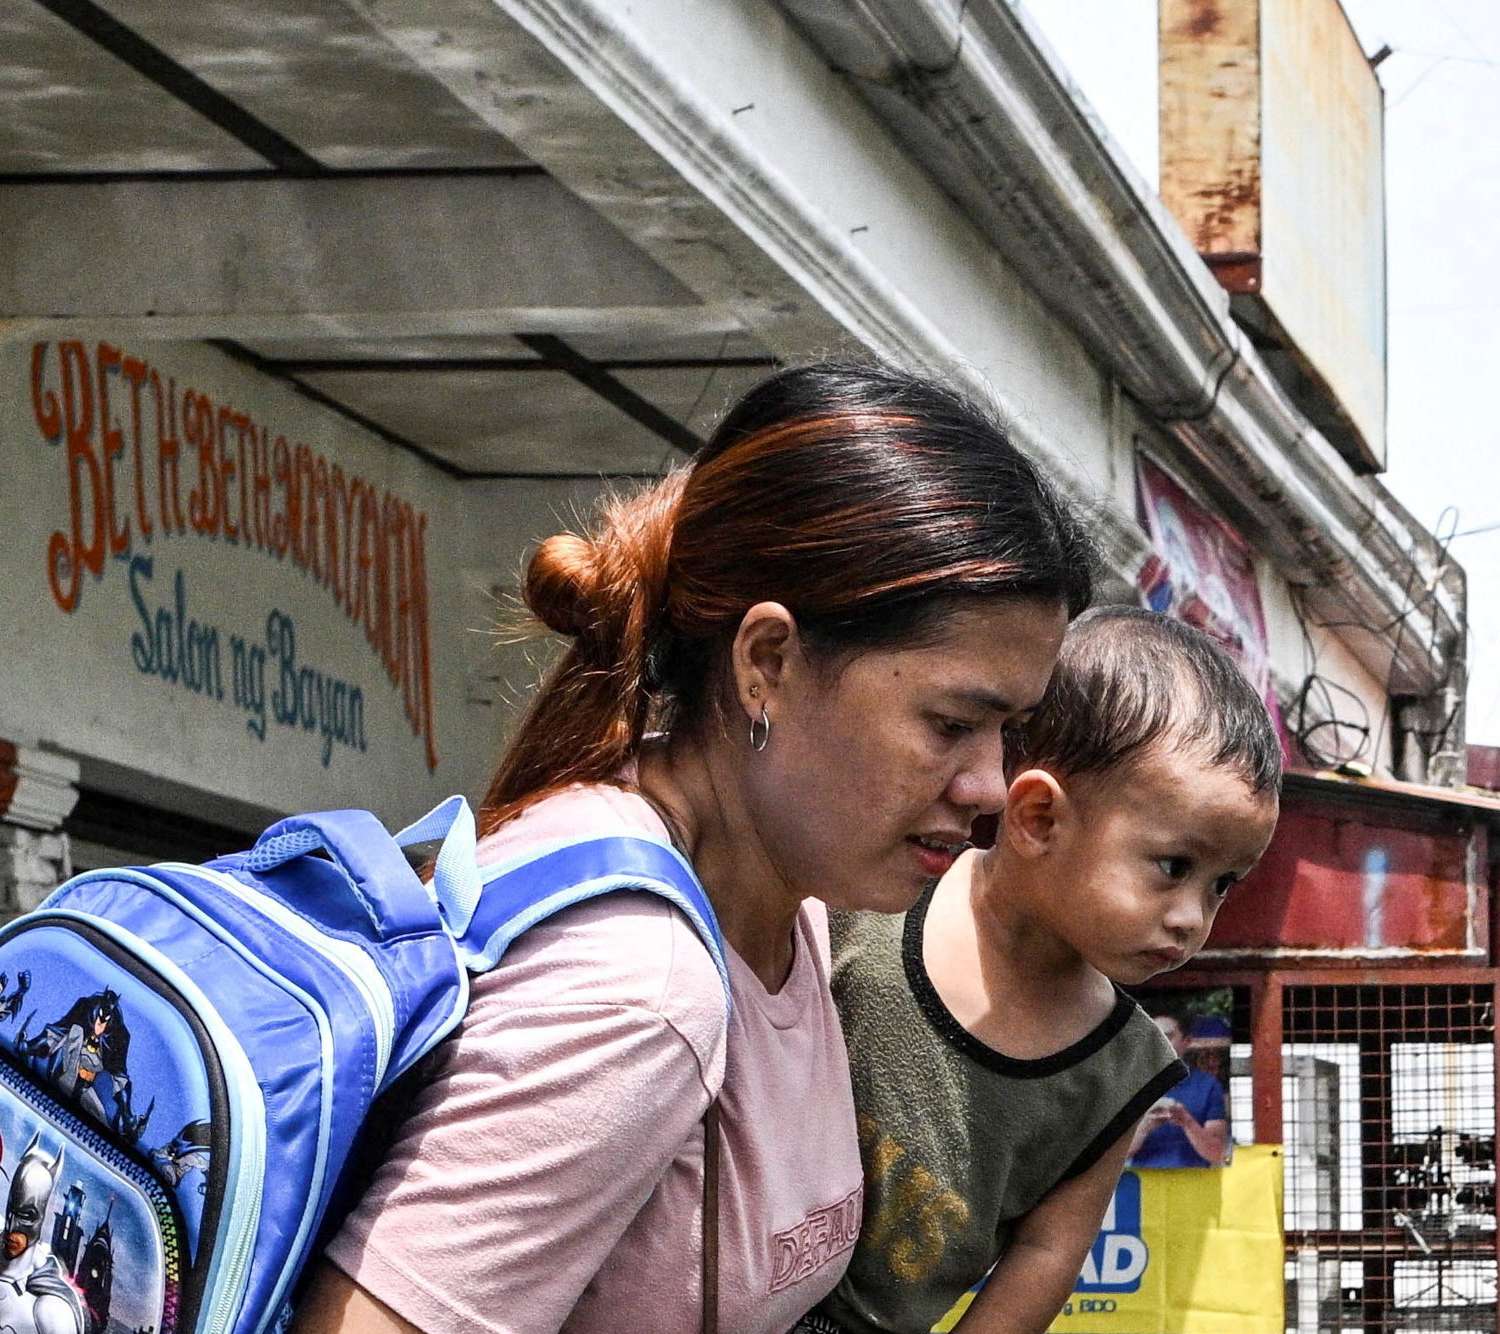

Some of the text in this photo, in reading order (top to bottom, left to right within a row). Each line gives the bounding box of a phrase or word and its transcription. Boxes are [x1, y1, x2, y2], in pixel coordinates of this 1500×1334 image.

[30, 340, 186, 613] BETH
[129, 555, 366, 768] Salon ng Bayan
[771, 1197, 861, 1288] DEFAU
[1079, 1300, 1118, 1313] BDO
